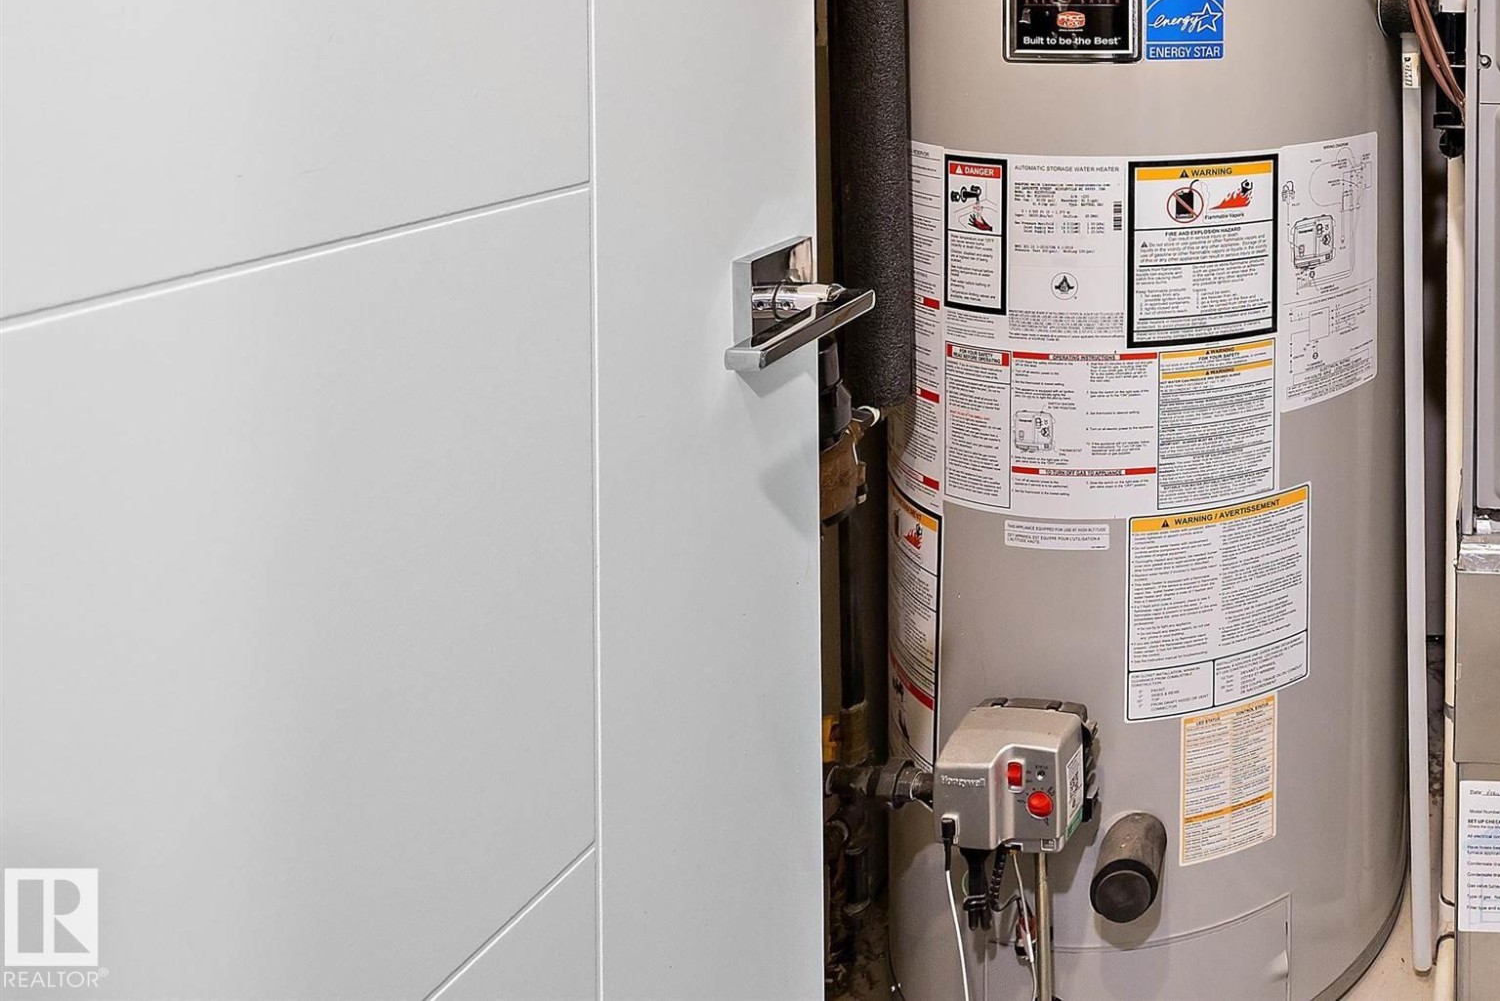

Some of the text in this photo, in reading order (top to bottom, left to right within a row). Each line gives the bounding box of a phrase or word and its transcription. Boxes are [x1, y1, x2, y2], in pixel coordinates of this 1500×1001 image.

[1150, 14, 1202, 33] energy
[1023, 37, 1044, 45] Built
[1059, 37, 1072, 45] be
[1075, 37, 1091, 45] the
[1150, 46, 1221, 58] ENERGY STAR
[964, 164, 995, 176] DANGER
[1191, 168, 1233, 177] WARNING
[1174, 514, 1213, 526] WARNING
[1219, 499, 1281, 519] AVERTISSEMENT
[940, 775, 986, 788] Honeywell
